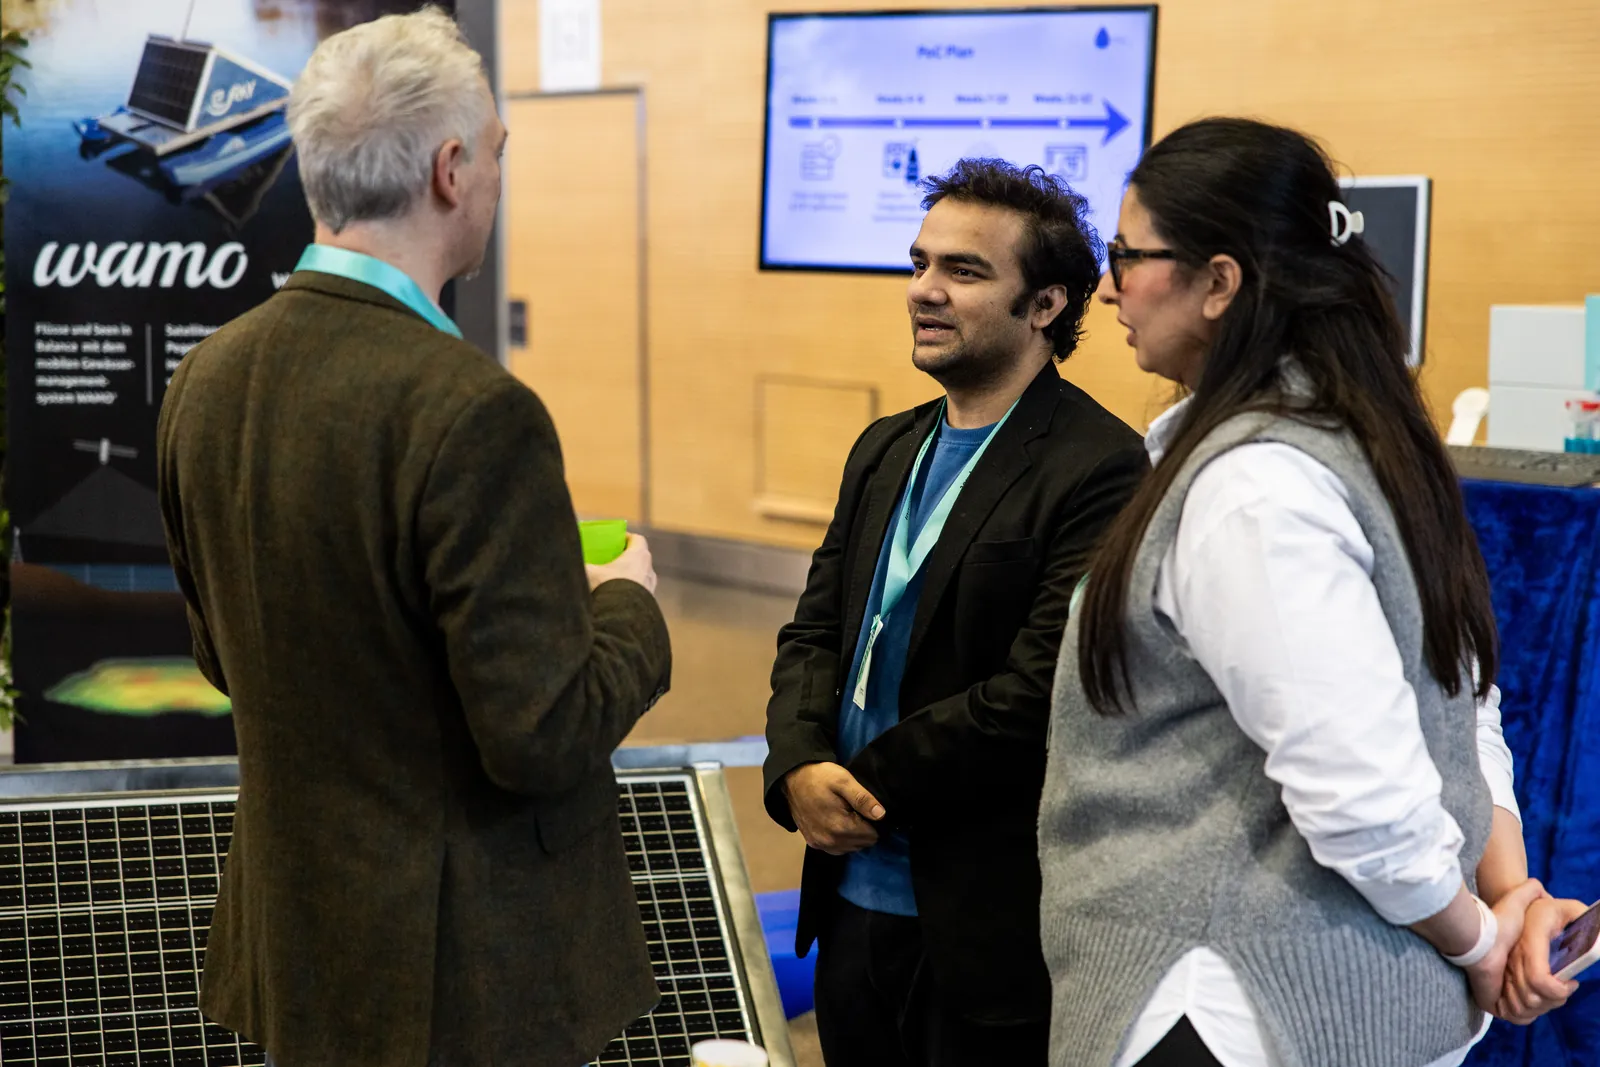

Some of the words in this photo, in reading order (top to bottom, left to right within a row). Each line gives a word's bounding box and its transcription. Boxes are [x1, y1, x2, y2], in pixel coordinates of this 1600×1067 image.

[946, 43, 975, 60] Plan
[33, 241, 249, 289] wamo
[35, 321, 70, 336] Flüsse
[71, 321, 92, 336] und
[93, 321, 120, 336] Seen
[121, 321, 133, 336] in
[35, 339, 79, 353] Balance
[81, 339, 100, 353] mit
[101, 339, 127, 353] dem
[35, 356, 80, 370] mobilen
[81, 356, 136, 371] Gewässer-
[35, 374, 111, 389] management-
